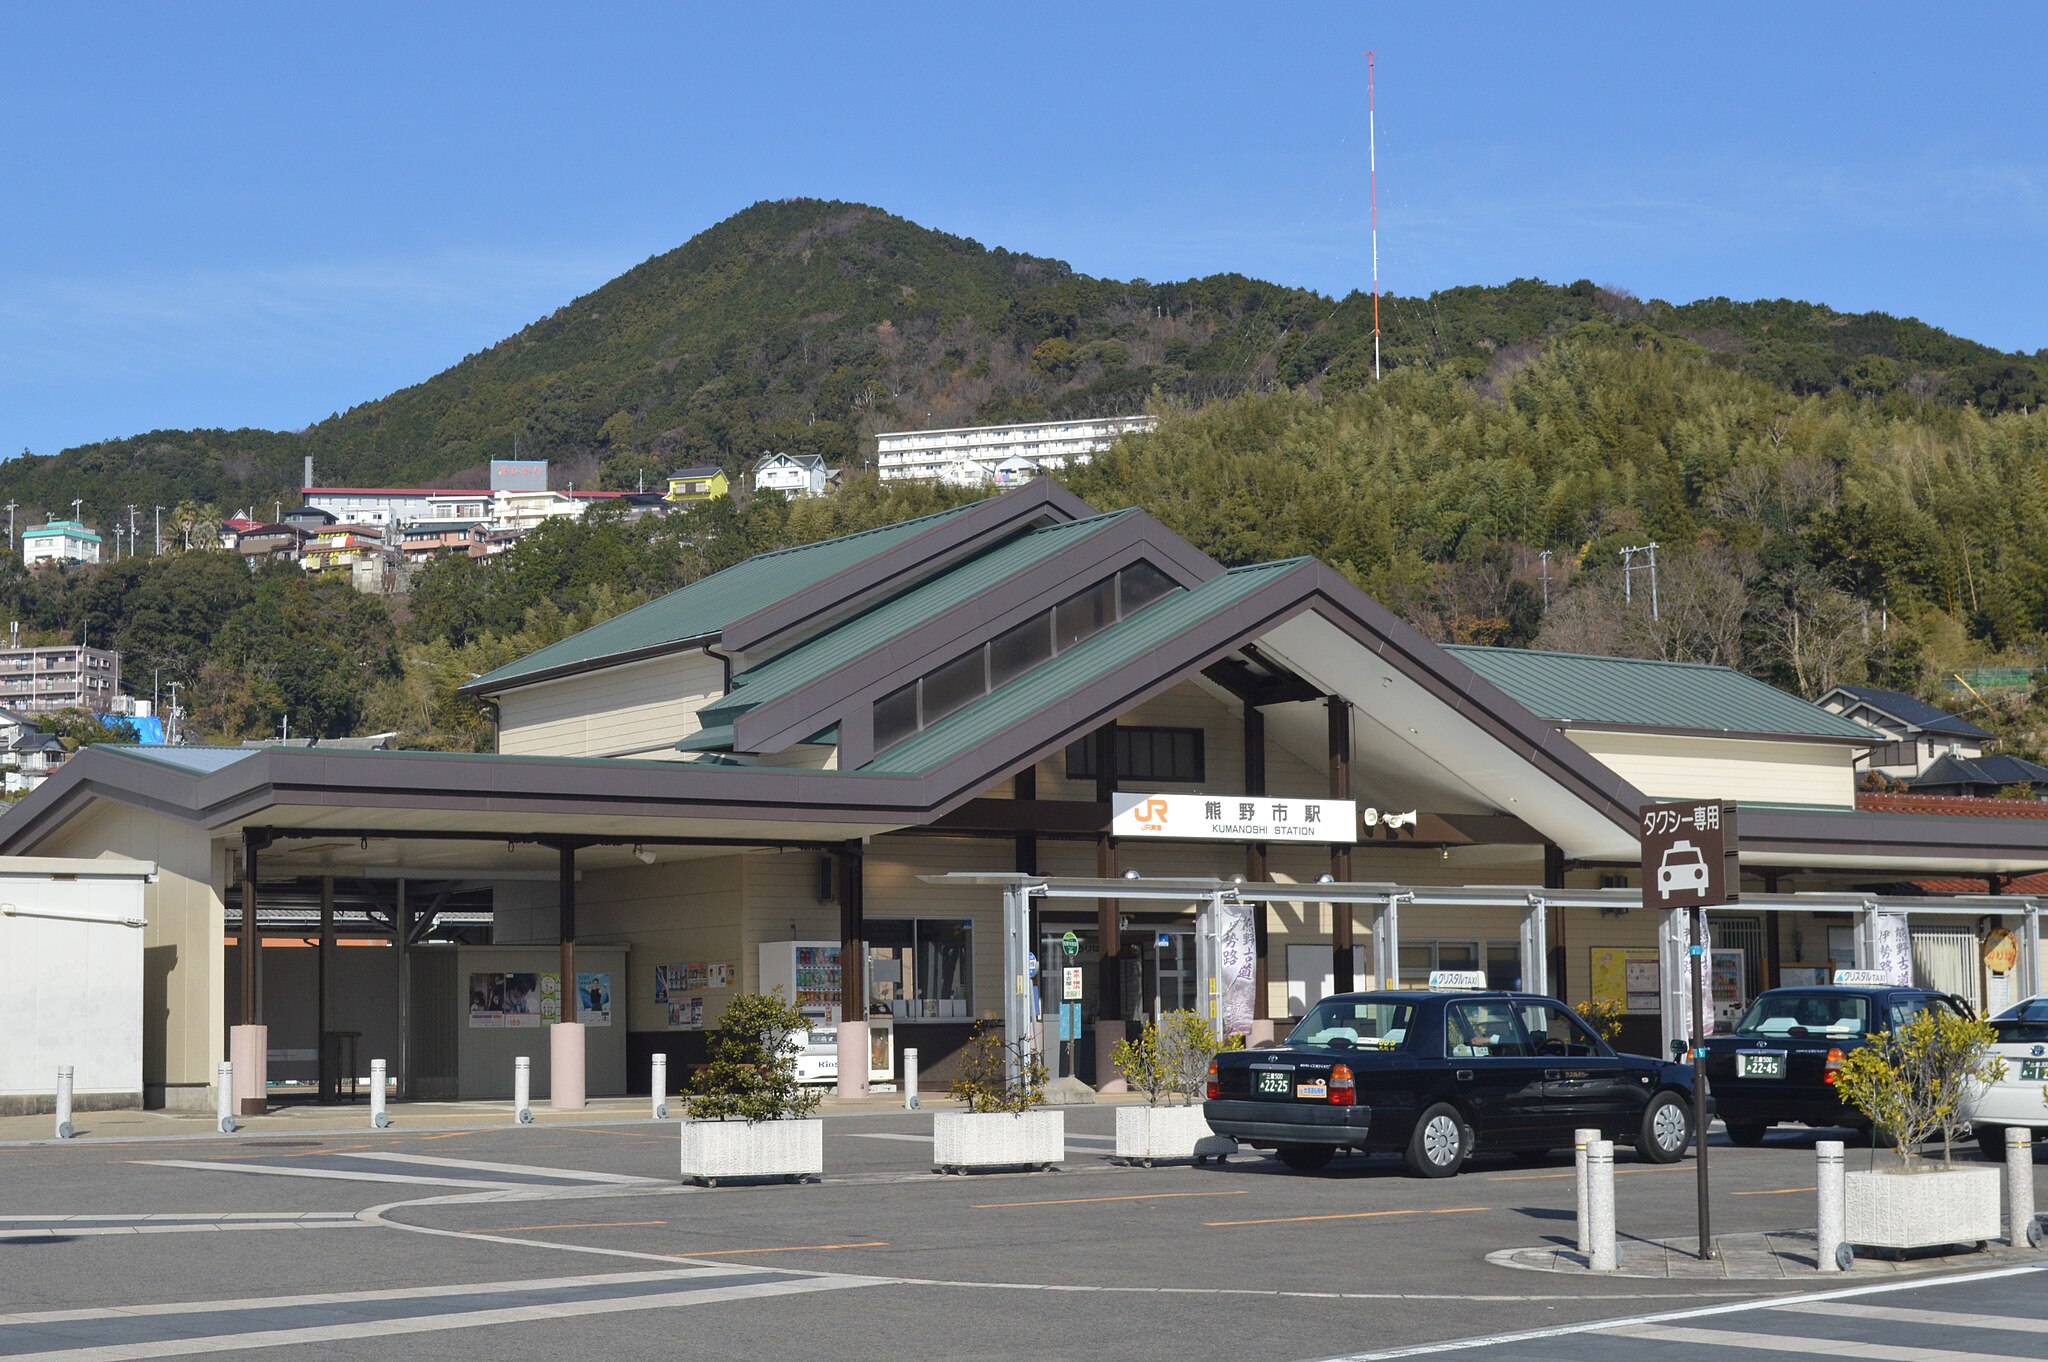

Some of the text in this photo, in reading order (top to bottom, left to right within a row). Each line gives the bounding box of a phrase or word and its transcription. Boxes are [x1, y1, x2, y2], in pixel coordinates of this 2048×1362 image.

[1134, 799, 1168, 823] JR
[1204, 801, 1321, 823] 熊野市駅
[1644, 805, 1719, 836] タクシー専用
[1212, 824, 1315, 836] KUMANOSHI STATION
[1880, 930, 1892, 972] 伊勢路
